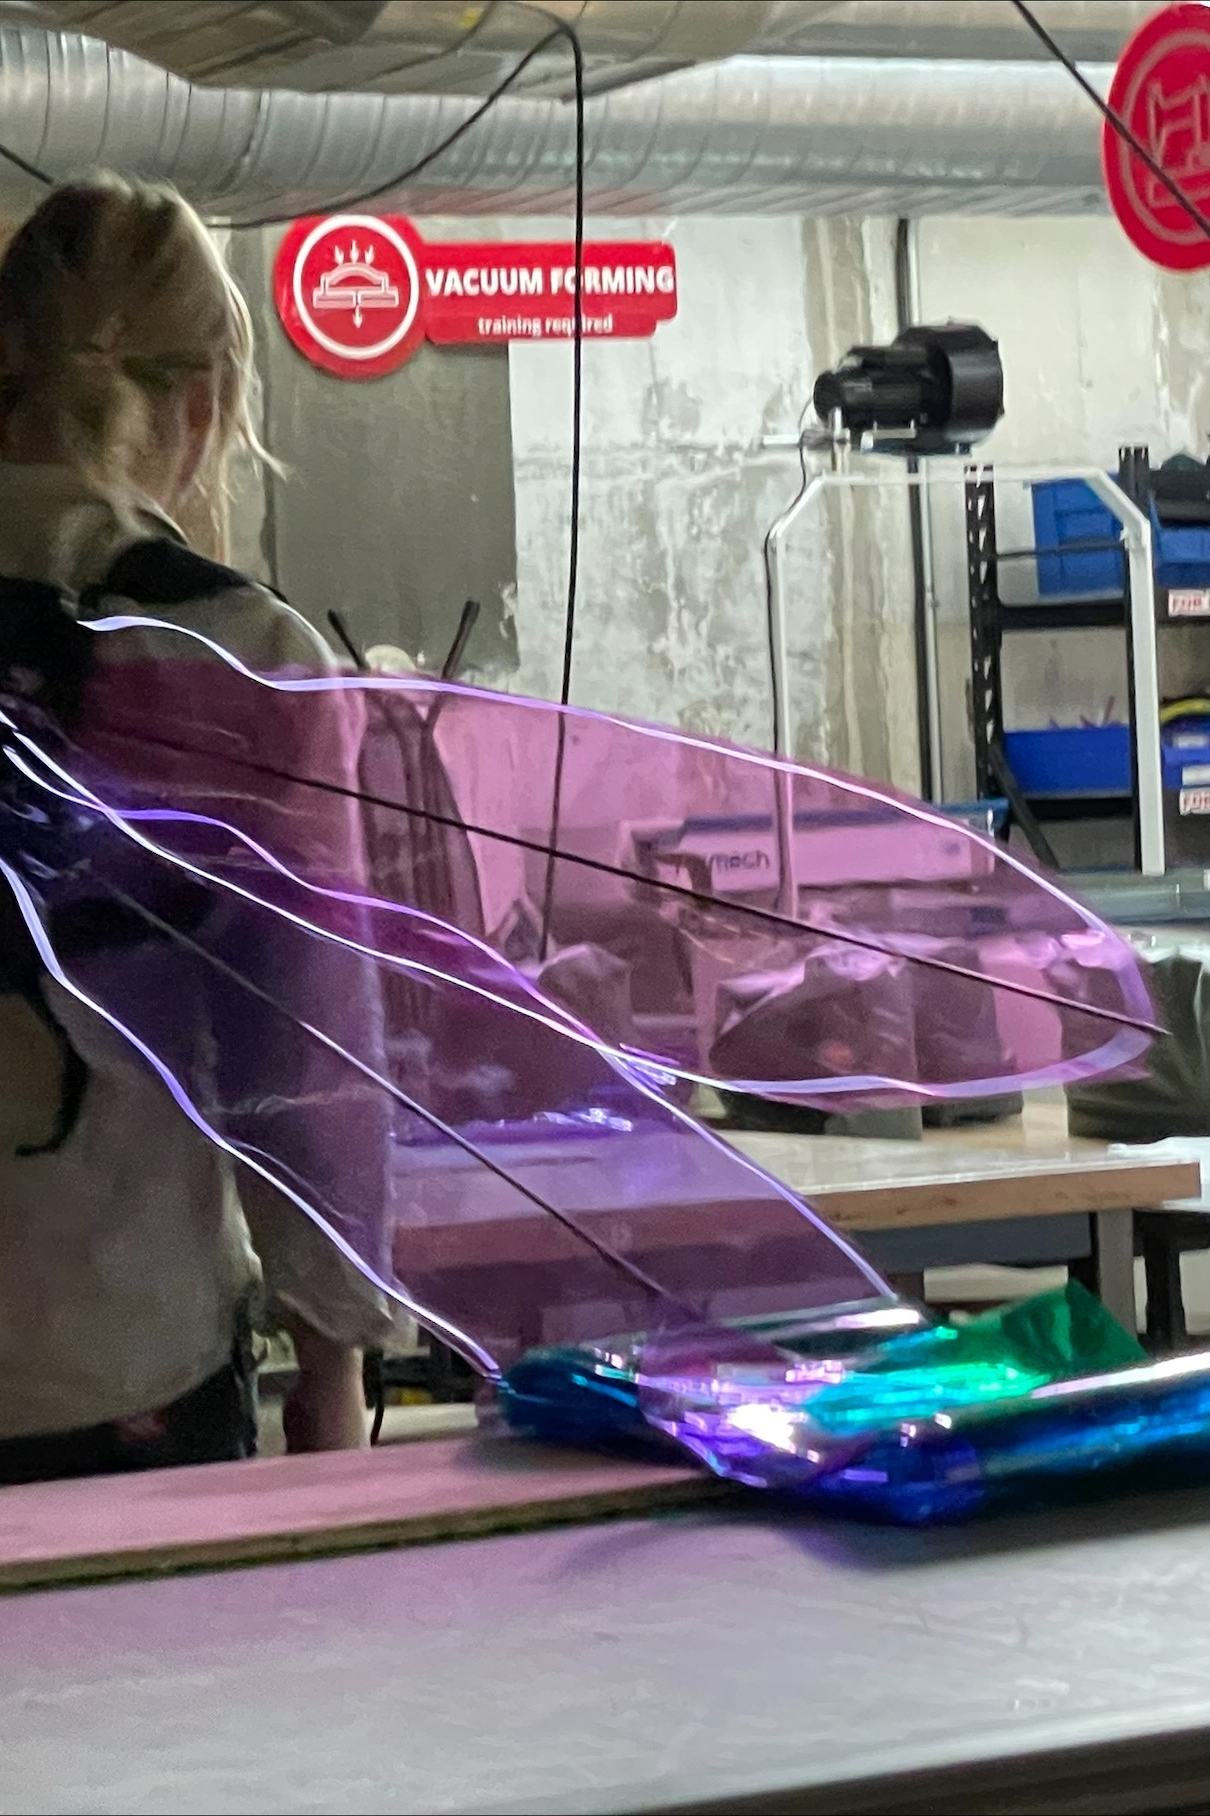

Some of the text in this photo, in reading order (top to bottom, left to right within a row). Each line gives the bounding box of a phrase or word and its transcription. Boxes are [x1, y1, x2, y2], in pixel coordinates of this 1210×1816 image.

[425, 265, 674, 297] VACUUM FORMING
[478, 315, 541, 337] training
